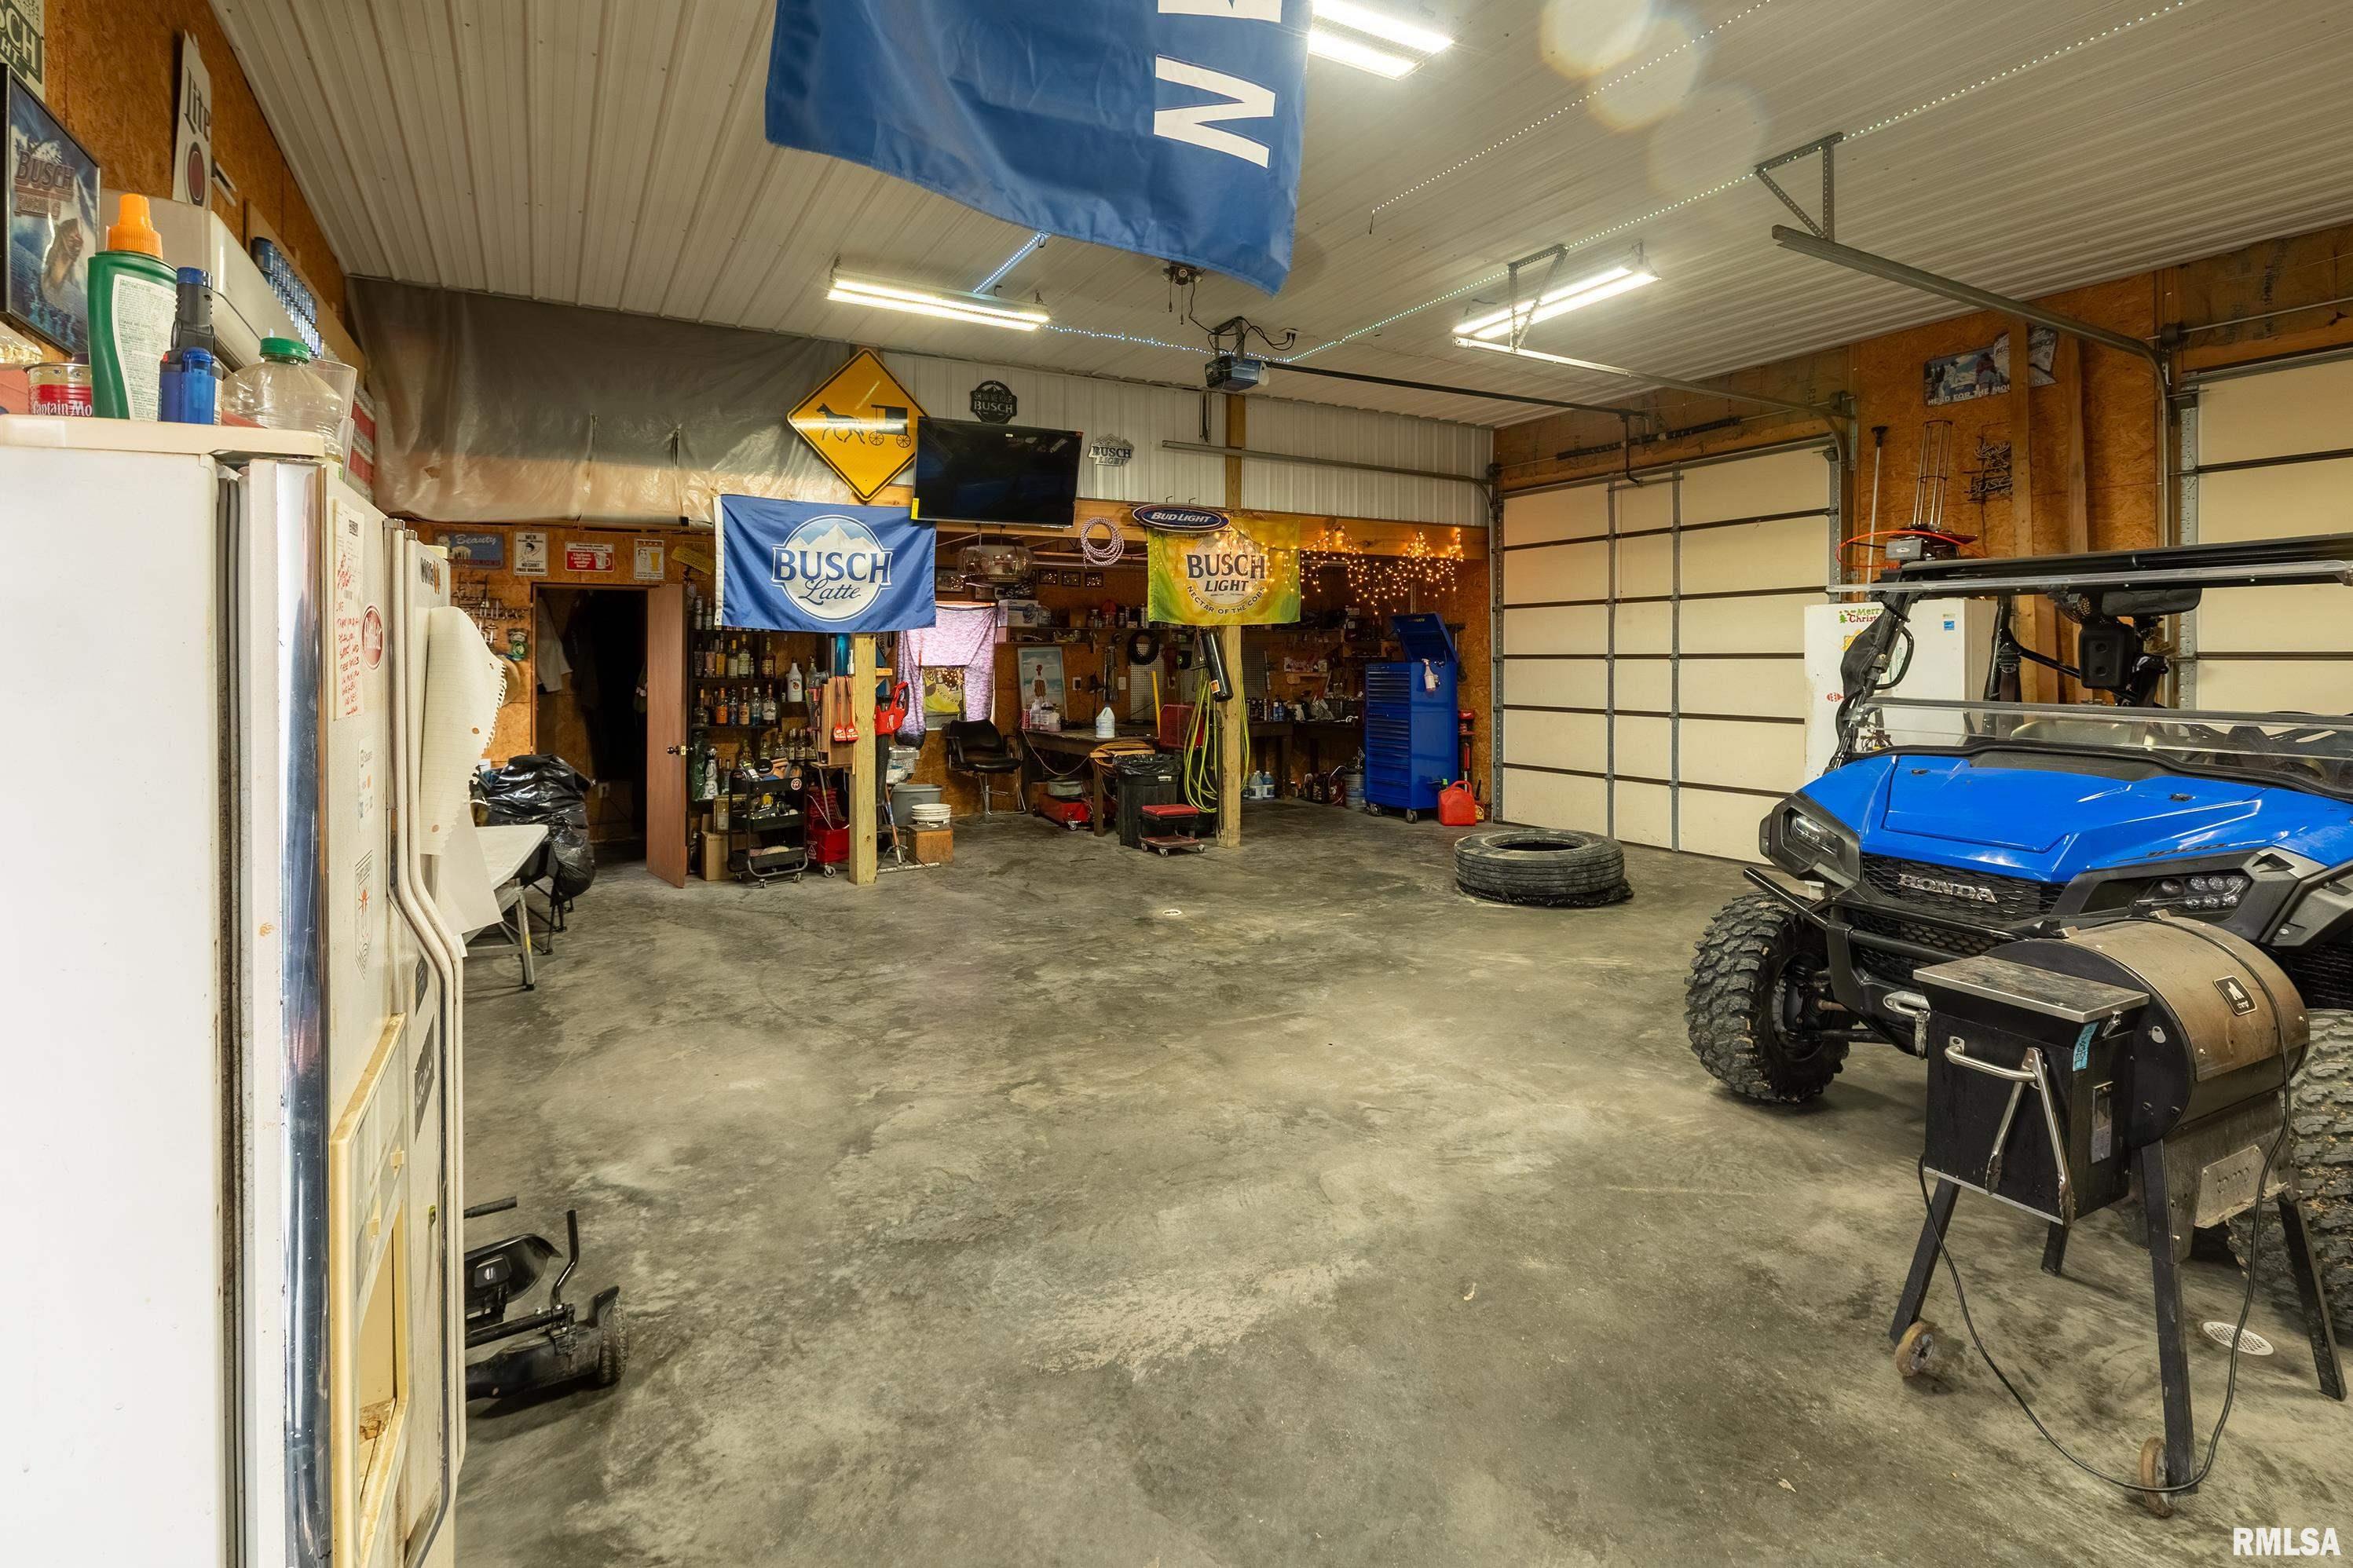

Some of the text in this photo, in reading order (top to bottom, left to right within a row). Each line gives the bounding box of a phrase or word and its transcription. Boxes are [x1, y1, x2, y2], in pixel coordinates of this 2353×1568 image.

[184, 66, 210, 142] Lite
[15, 150, 75, 192] BUSCH
[974, 400, 1013, 414] BUSCH
[1927, 396, 1951, 407] HEAD
[1953, 391, 1971, 400] FOR
[1974, 388, 1990, 398] THE
[33, 400, 68, 416] Captain
[1092, 445, 1132, 459] BUSCH
[1971, 476, 2014, 496] BUSC
[1151, 512, 1212, 523] BUD LIGHT
[454, 534, 496, 545] Beauty
[774, 548, 892, 583] BUSCH
[1186, 553, 1267, 579] BUSCH
[798, 578, 862, 606] Latte
[1204, 579, 1250, 593] LIGHT
[1187, 585, 1215, 613] NECTAR
[1231, 605, 1247, 615] THE
[1247, 585, 1266, 606] COBS
[1848, 607, 1884, 623] Merr Christ
[1897, 873, 1998, 904] HONDA
